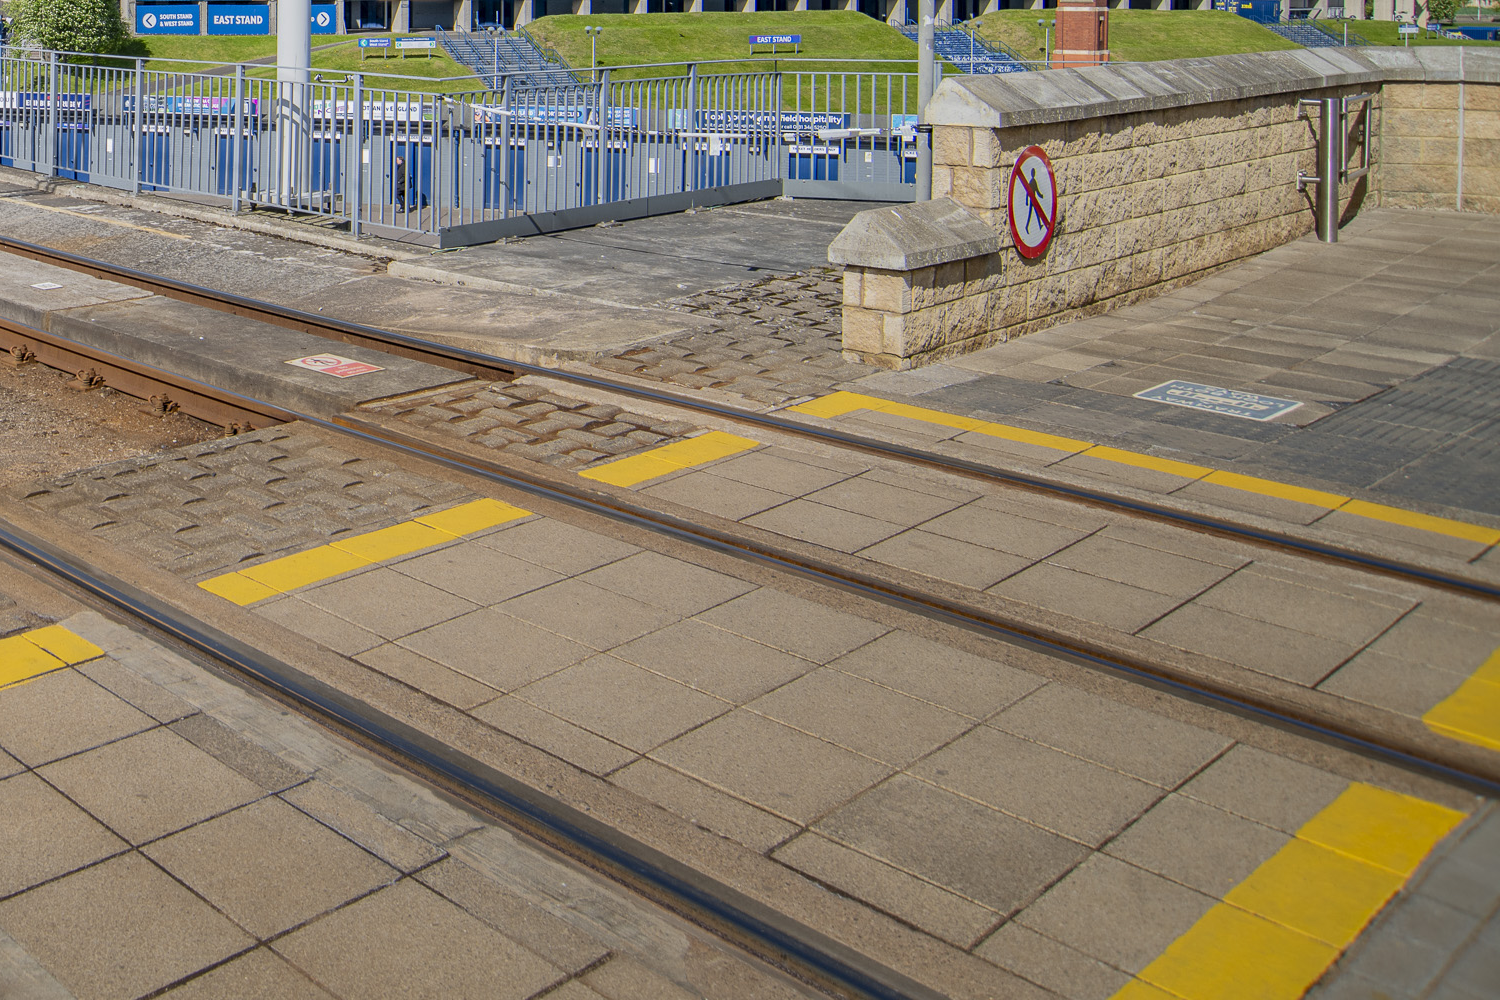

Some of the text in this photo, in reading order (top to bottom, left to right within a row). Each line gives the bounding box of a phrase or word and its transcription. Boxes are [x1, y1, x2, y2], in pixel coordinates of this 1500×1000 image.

[213, 15, 263, 25] EAST STAND
[757, 35, 792, 43] EAST STAND
[1150, 395, 1252, 416] TRAMWAY
